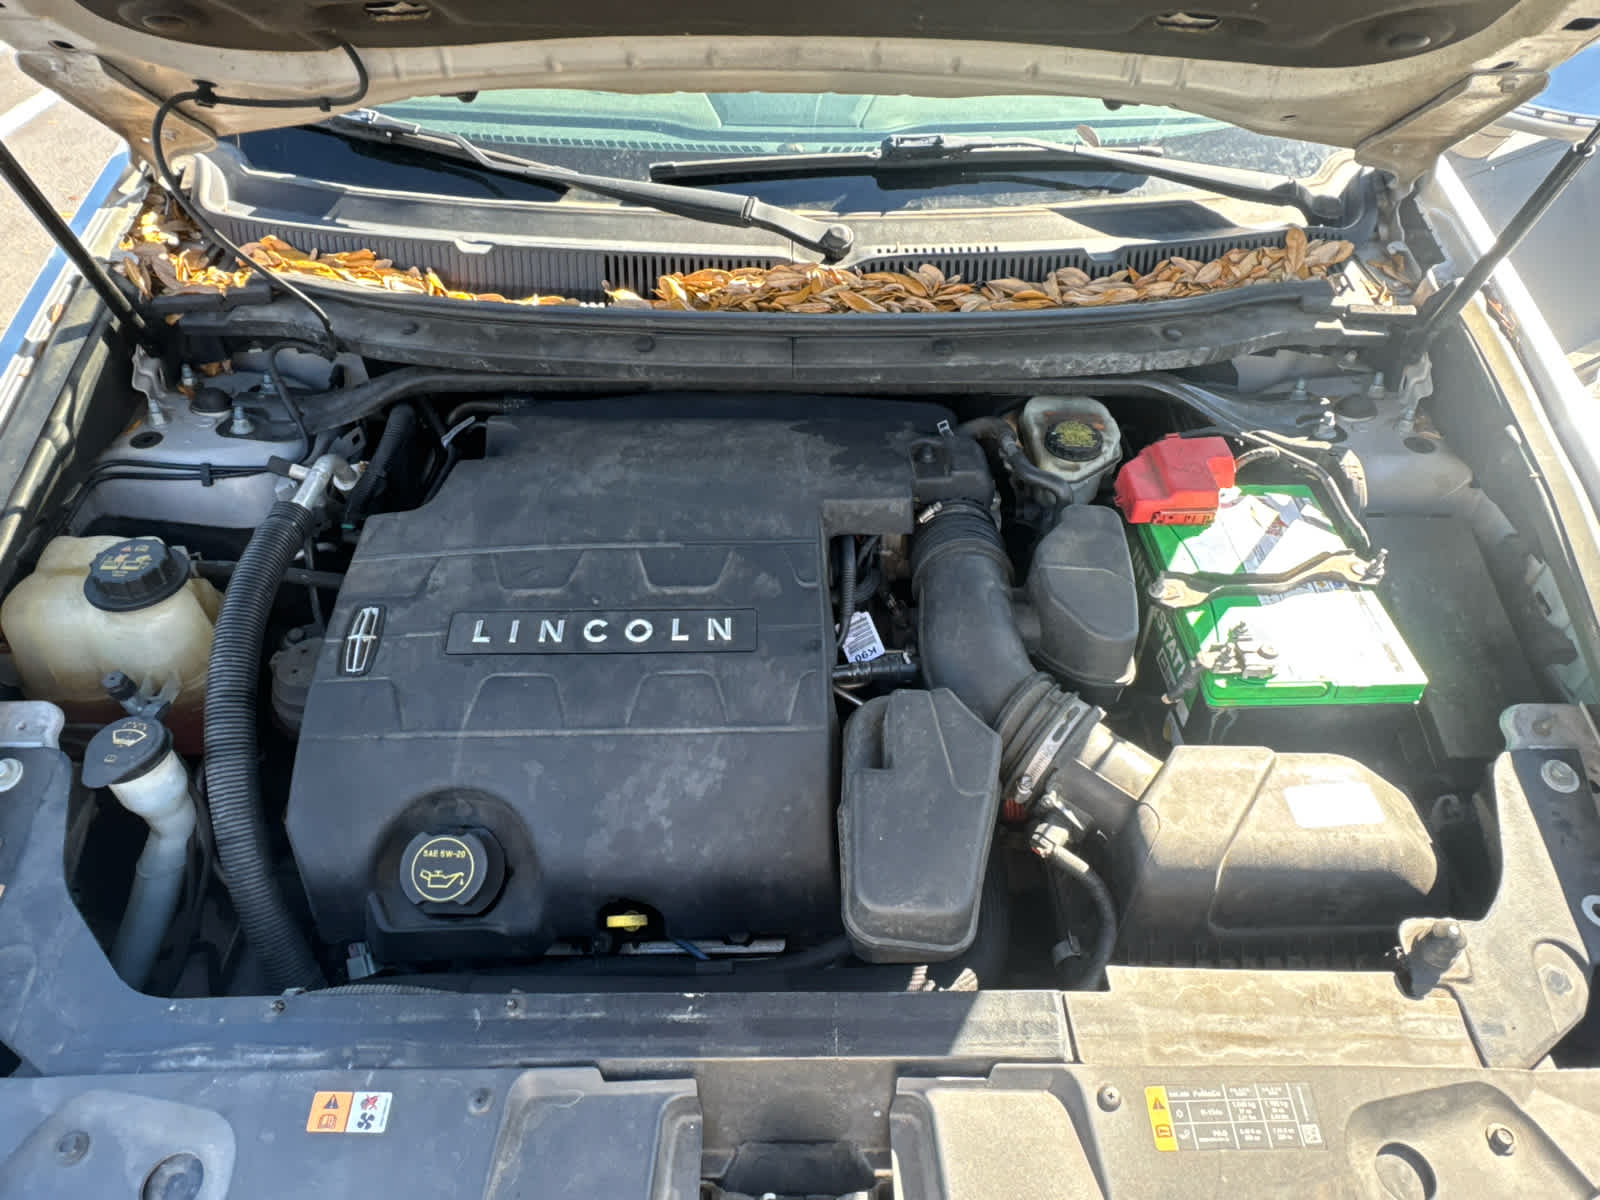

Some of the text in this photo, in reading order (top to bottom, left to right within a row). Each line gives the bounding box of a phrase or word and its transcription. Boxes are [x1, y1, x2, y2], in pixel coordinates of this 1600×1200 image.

[472, 617, 732, 643] LINCOLN
[423, 849, 466, 858] SAE 5W-20
